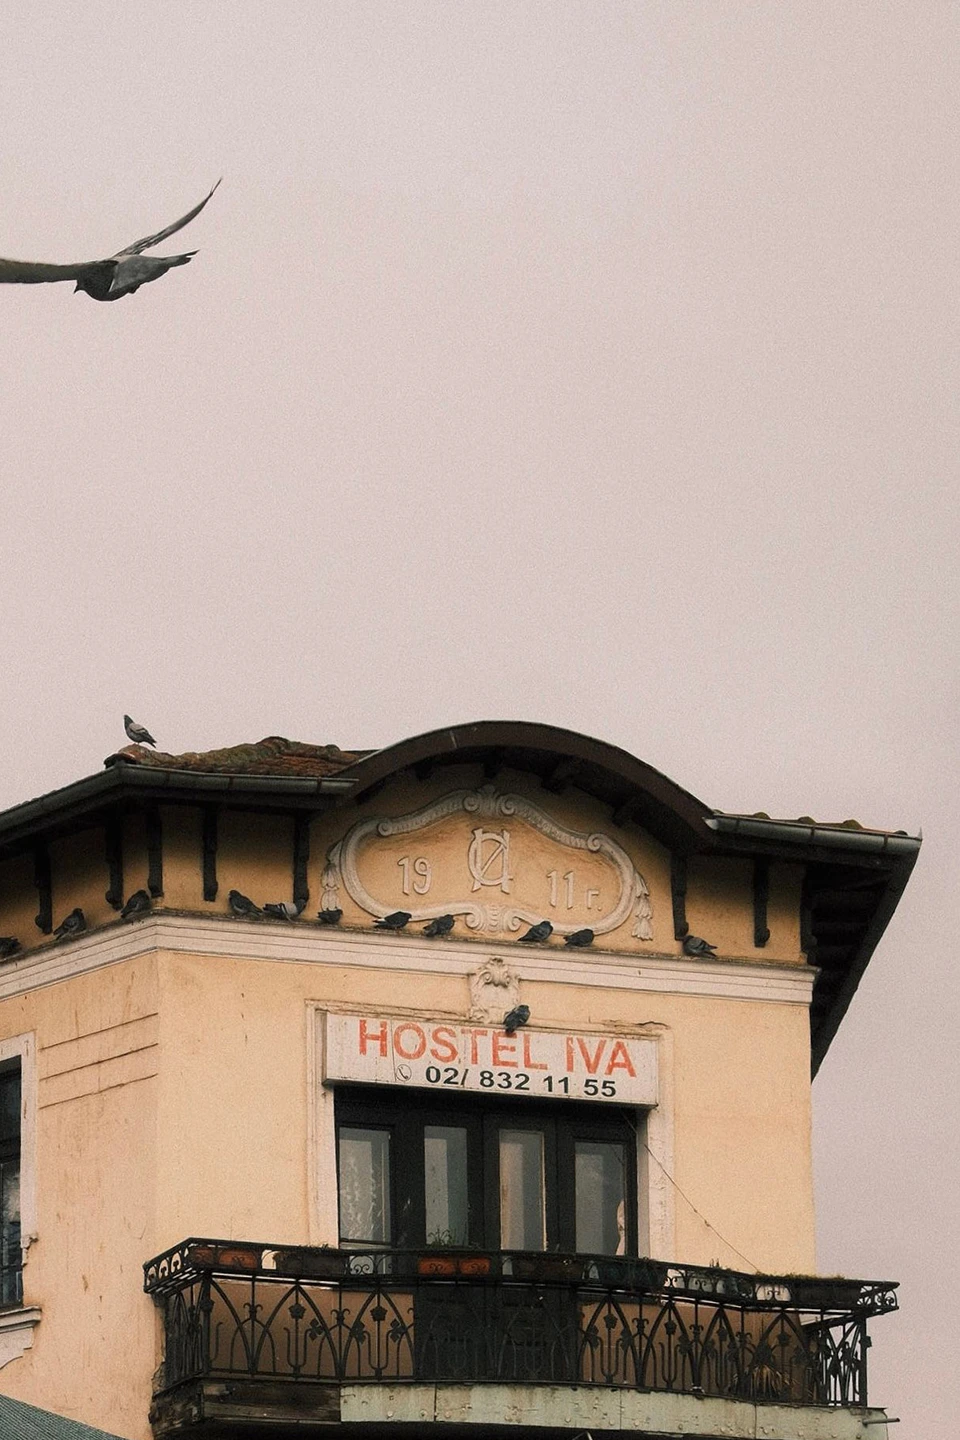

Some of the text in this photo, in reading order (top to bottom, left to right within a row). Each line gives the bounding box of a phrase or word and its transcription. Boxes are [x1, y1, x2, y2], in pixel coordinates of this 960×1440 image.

[397, 856, 433, 895] 19
[546, 870, 576, 910] 11
[358, 1019, 637, 1078] HOSTEL IVA
[425, 1065, 617, 1098] 02/ 832 11 55
